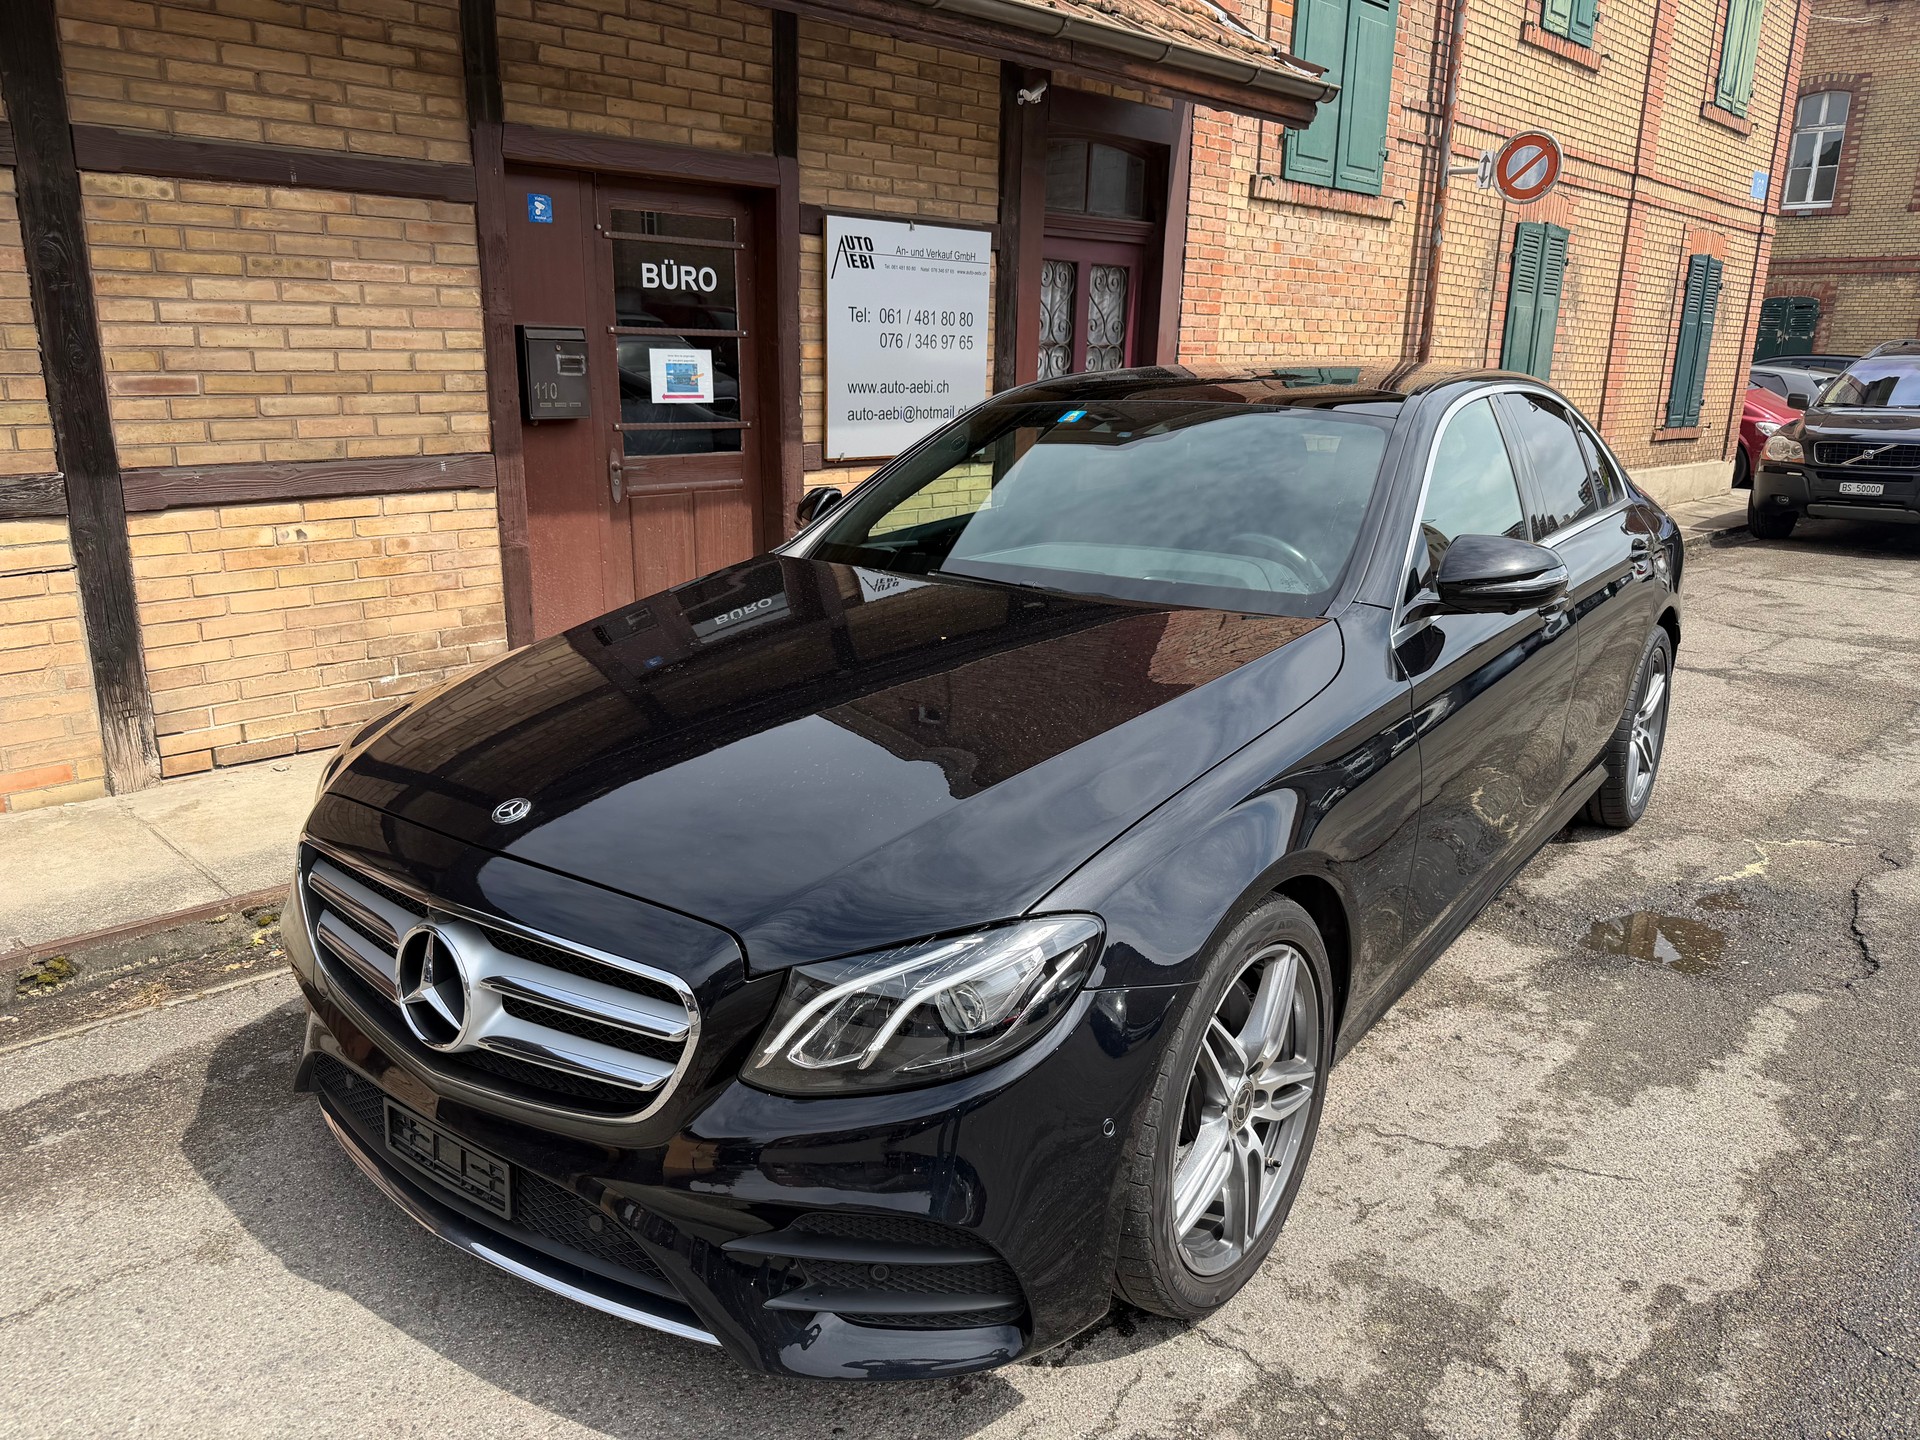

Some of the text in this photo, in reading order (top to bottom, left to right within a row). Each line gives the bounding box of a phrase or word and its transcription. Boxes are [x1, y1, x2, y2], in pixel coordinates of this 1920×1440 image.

[895, 245, 976, 262] An- und Verkauf GmbH
[641, 259, 718, 292] BÜRO
[848, 306, 974, 328] Tel: 061 / 481 80 80
[879, 333, 974, 350] 076 / 346 97 65
[534, 382, 558, 399] 110
[847, 380, 950, 394] www.auto-aebi.ch
[847, 405, 967, 423] auto-aebi@hotmailc
[1842, 483, 1881, 494] BS 50000
